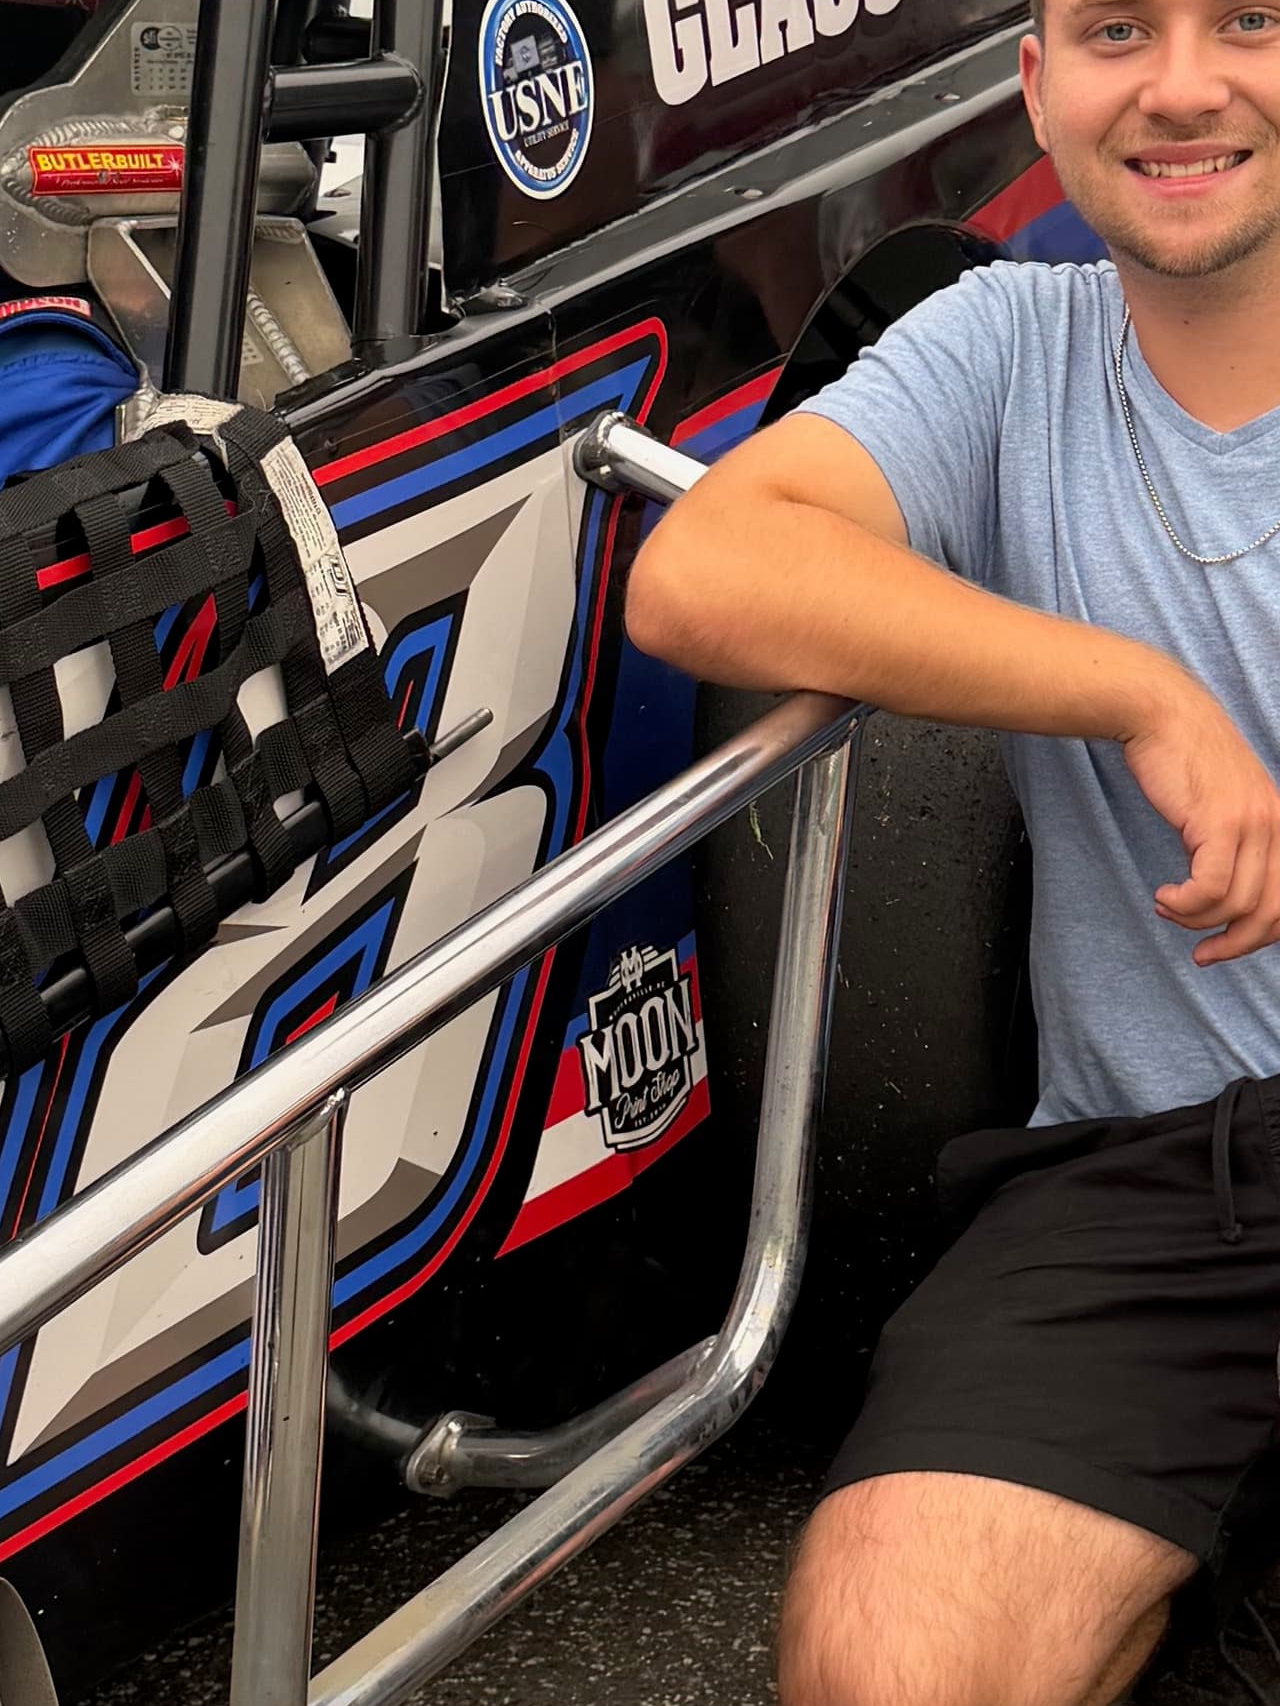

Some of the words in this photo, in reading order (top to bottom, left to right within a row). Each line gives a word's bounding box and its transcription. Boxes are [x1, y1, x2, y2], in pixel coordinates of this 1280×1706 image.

[495, 7, 516, 68] FACTORY
[488, 60, 589, 142] USNE
[36, 152, 164, 172] BUTLERBUILT
[579, 976, 699, 1108] MOON
[613, 1085, 650, 1130] Print
[650, 1068, 681, 1104] Shop
